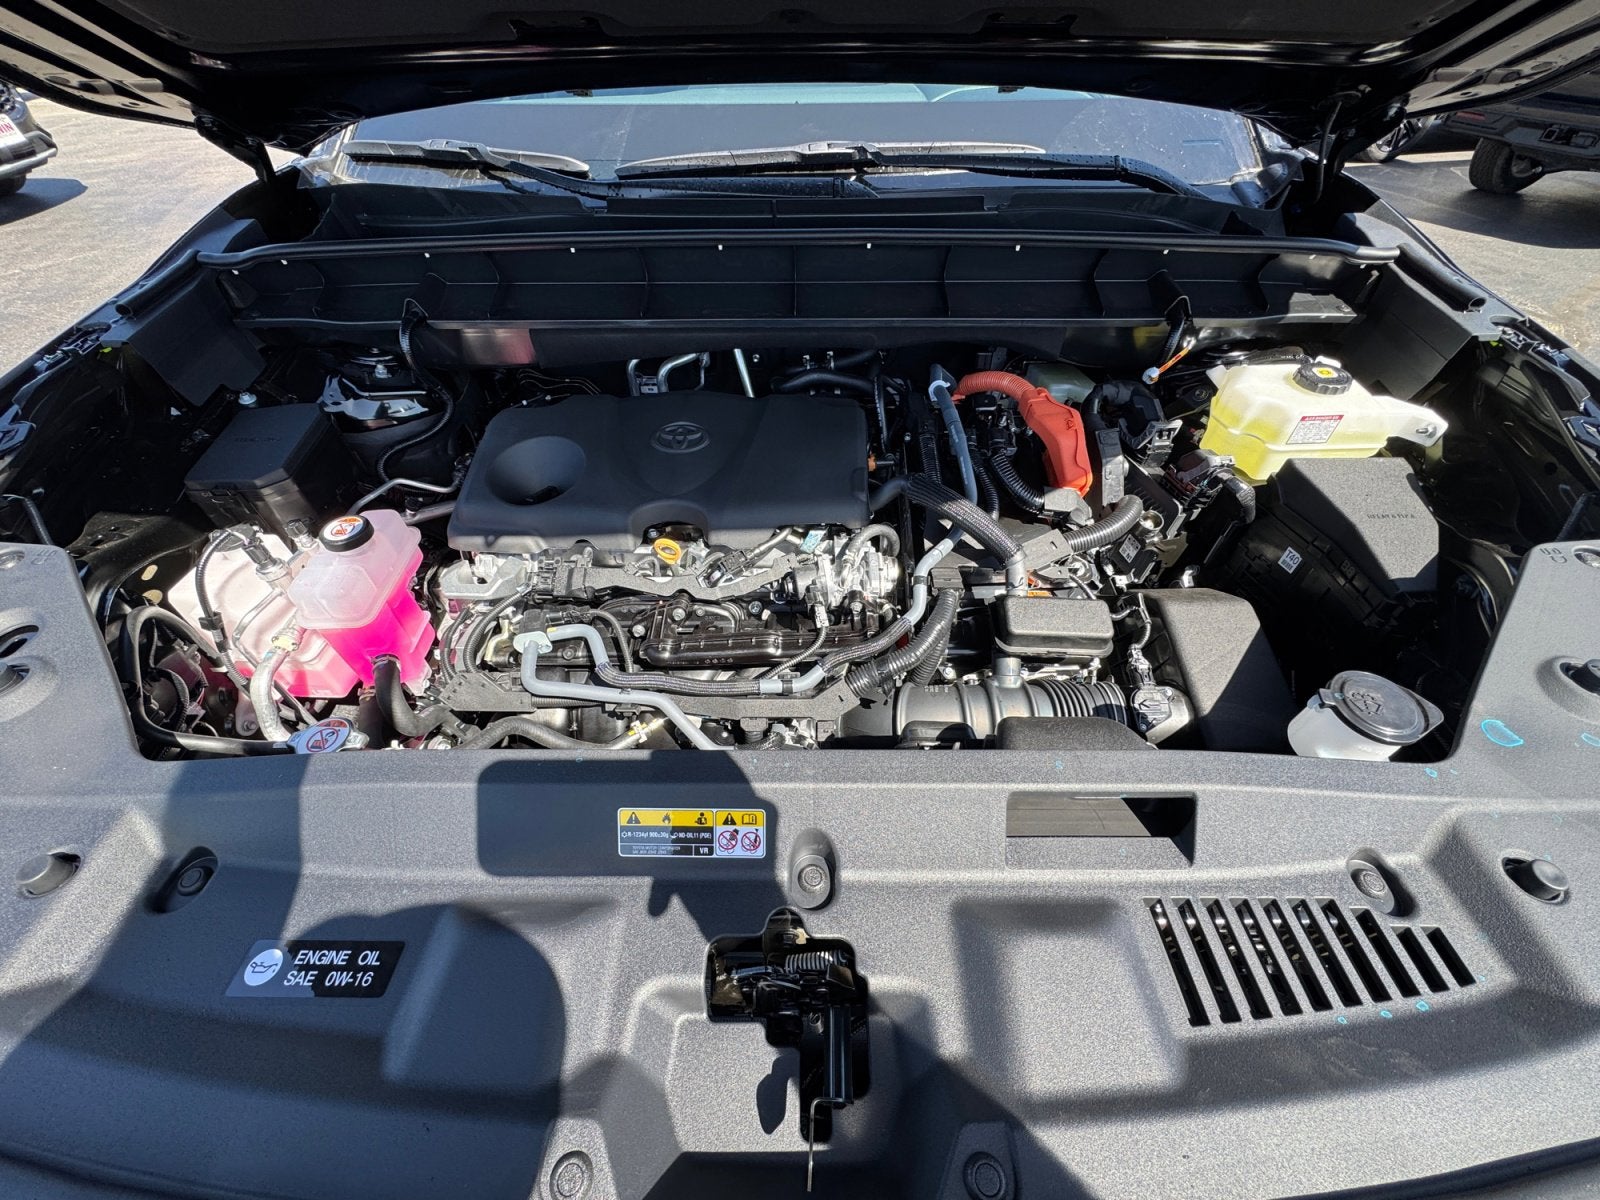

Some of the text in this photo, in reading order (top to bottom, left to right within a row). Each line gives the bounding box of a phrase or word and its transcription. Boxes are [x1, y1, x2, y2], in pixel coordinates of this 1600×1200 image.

[1286, 550, 1300, 565] T40
[699, 847, 709, 855] VR
[293, 950, 381, 966] ENGINE OIL
[283, 971, 374, 987] SAE 0W-16
